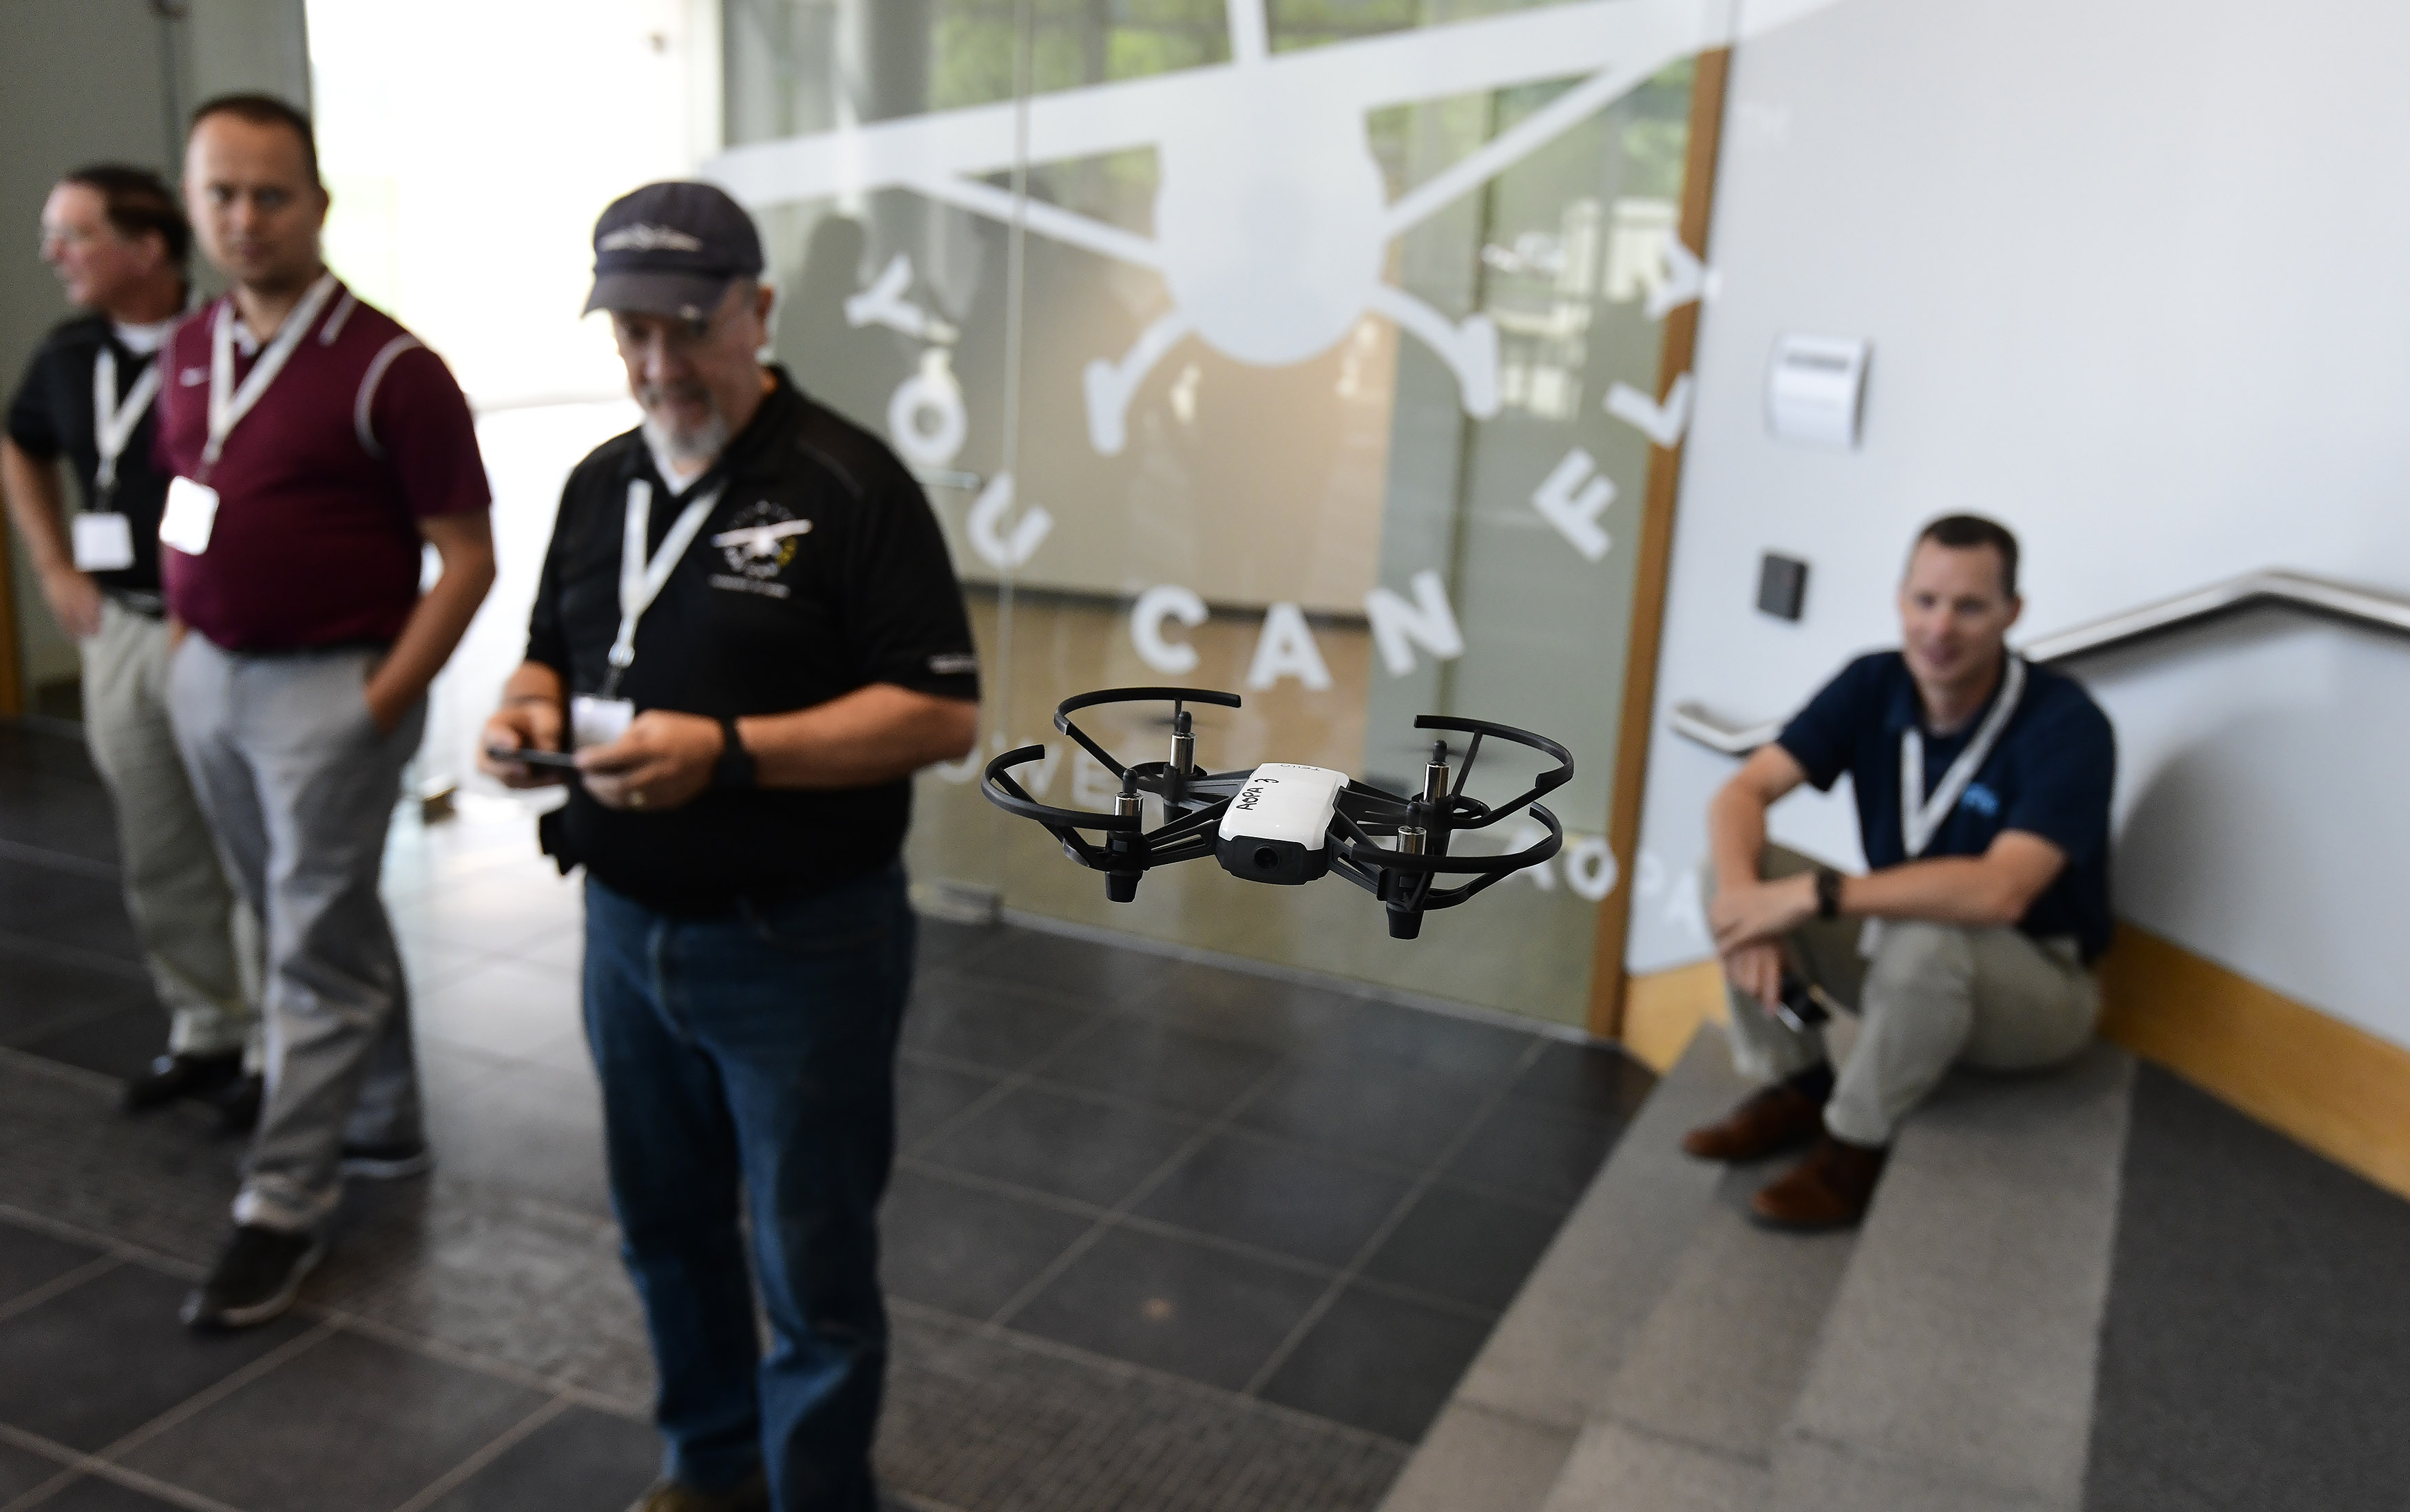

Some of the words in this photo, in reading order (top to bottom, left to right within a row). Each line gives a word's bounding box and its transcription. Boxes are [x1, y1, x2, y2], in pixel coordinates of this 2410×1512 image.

[846, 253, 1053, 567] YOU
[1131, 584, 1463, 691] CAN
[1533, 236, 1721, 562] FLY
